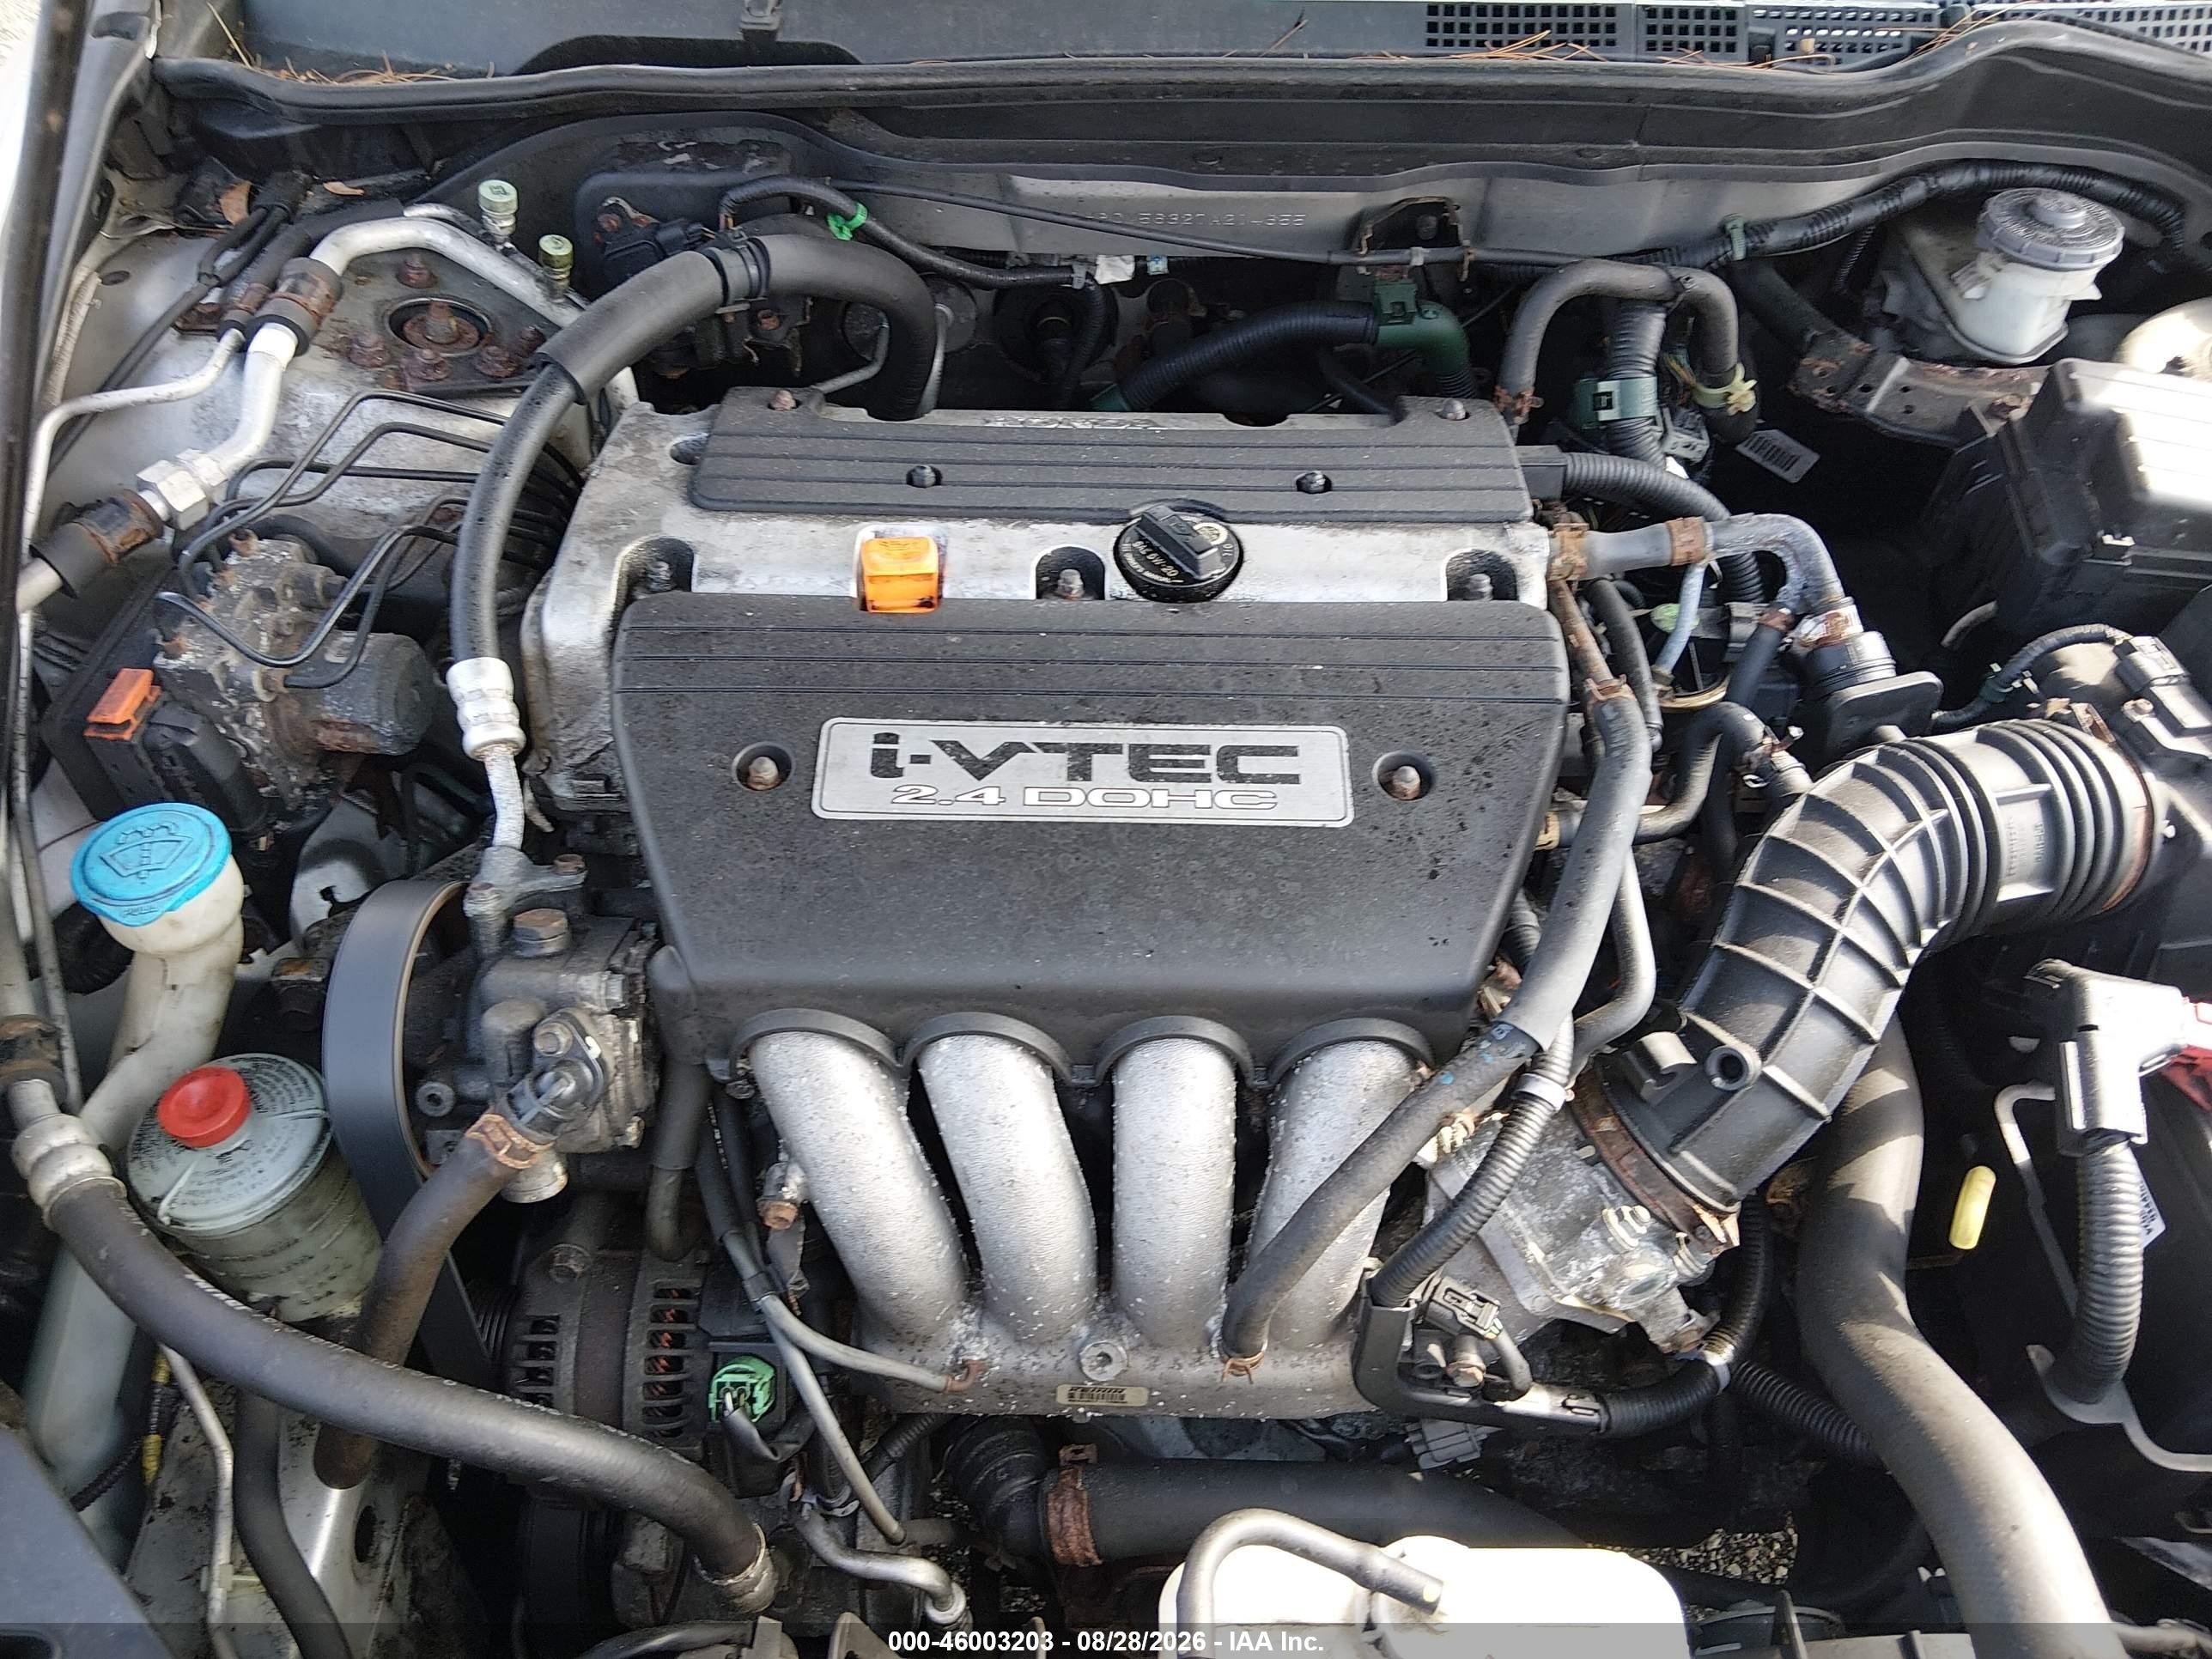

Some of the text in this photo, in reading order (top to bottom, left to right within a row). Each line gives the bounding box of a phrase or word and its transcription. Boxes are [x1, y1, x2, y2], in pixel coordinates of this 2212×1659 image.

[869, 732, 1300, 784] i-VTEC
[891, 785, 1278, 810] 2.4 DOHC
